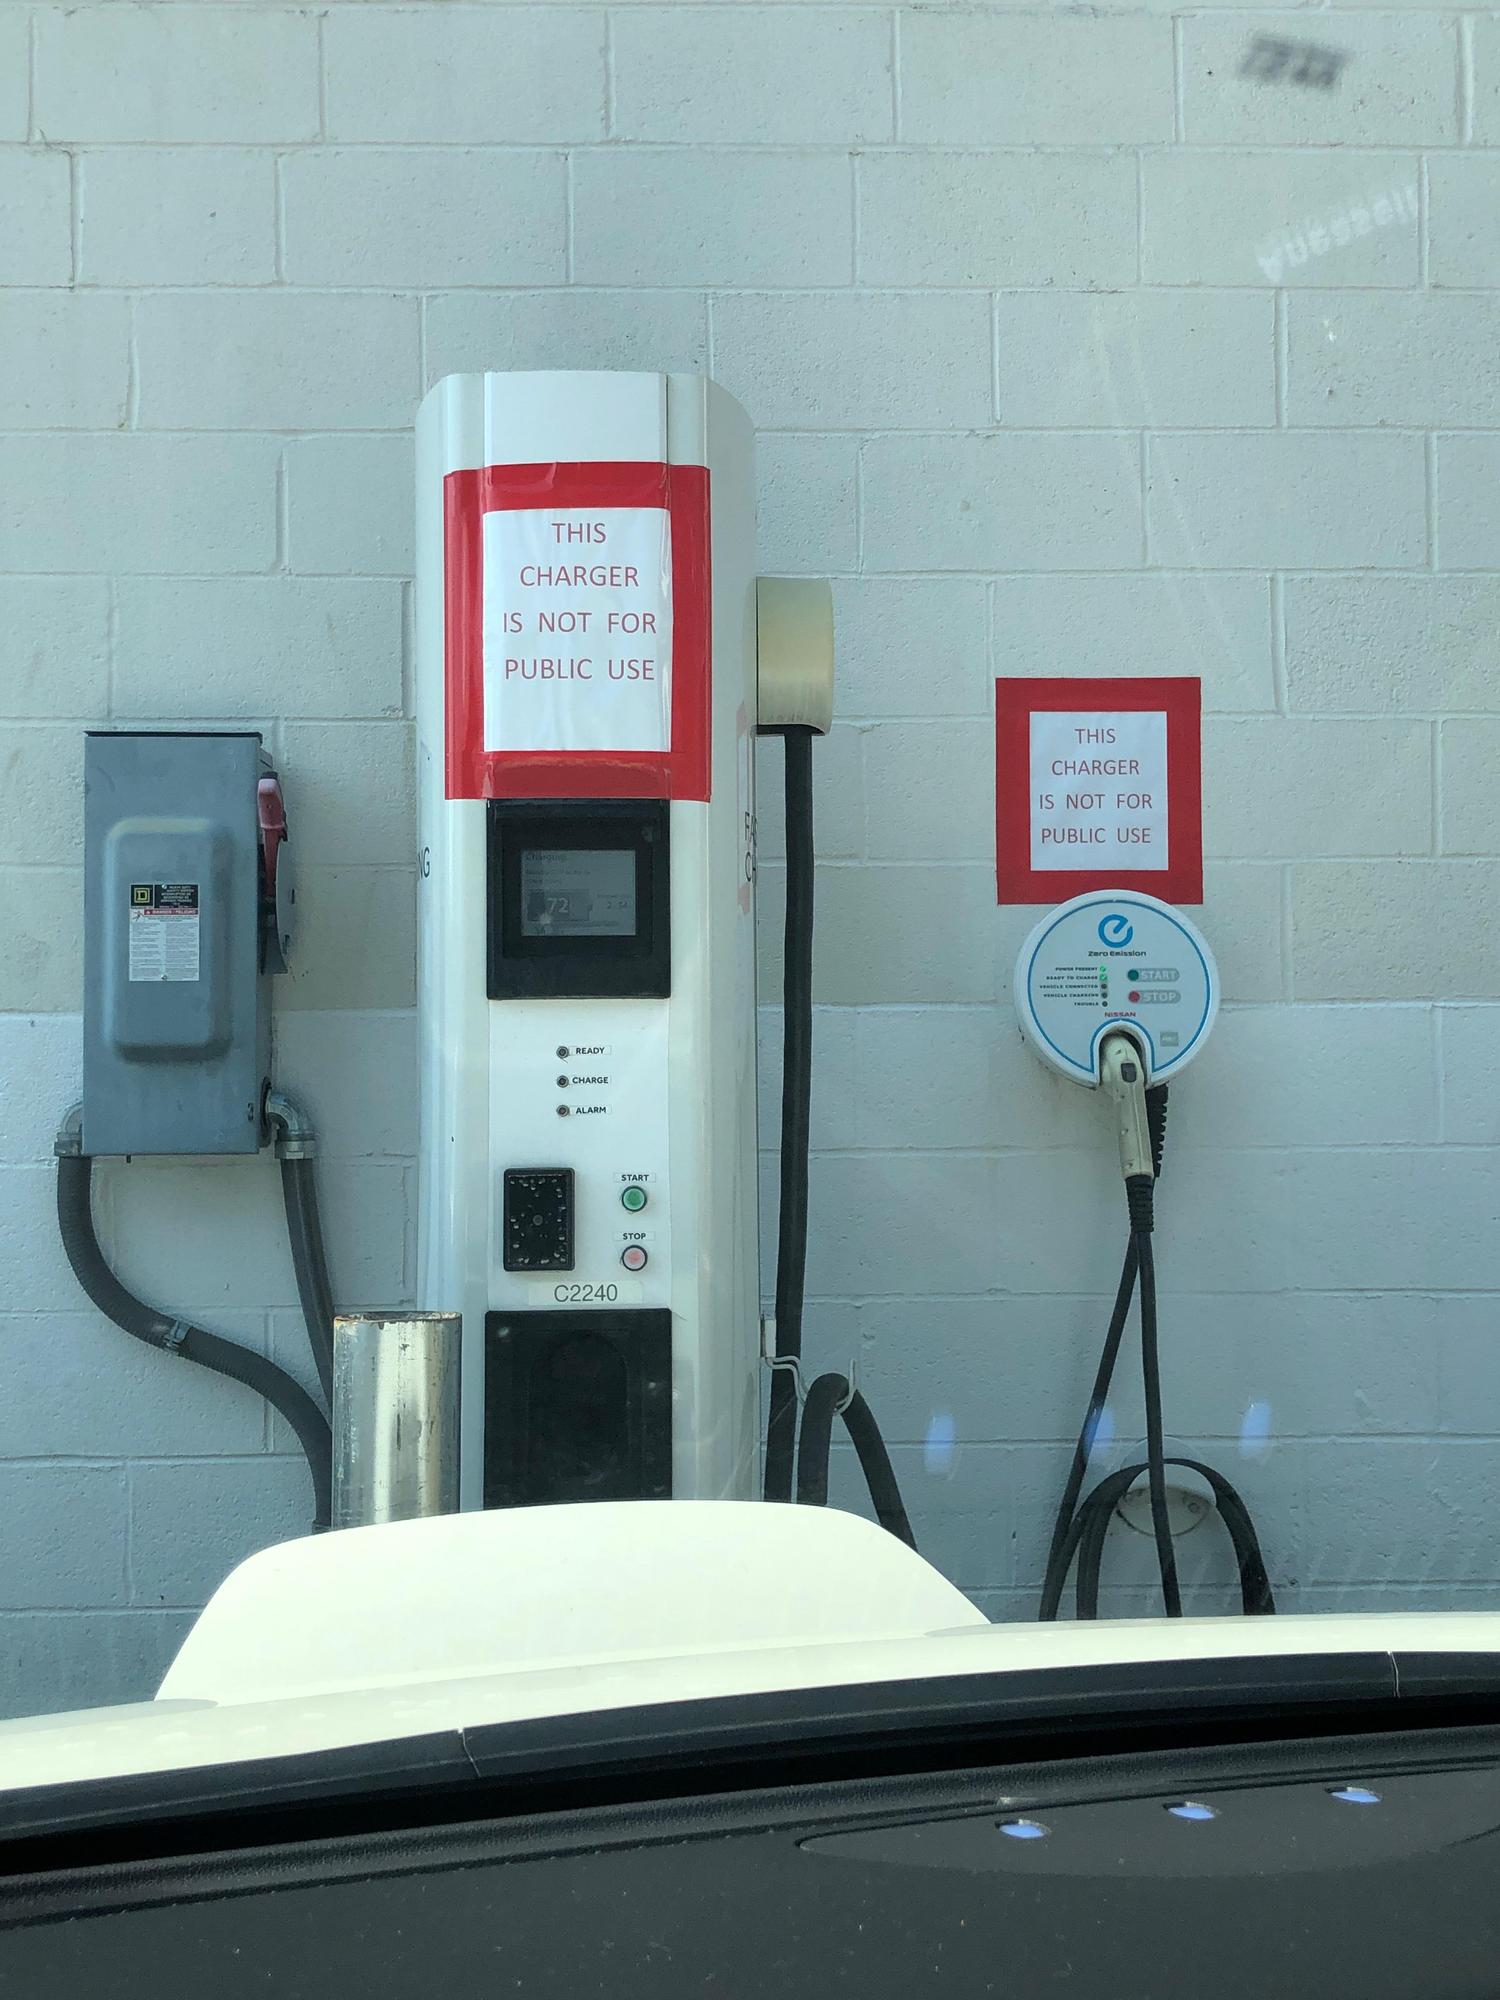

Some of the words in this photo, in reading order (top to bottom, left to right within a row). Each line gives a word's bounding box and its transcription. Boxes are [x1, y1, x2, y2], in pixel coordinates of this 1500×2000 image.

[551, 522, 607, 544] THIS
[520, 565, 639, 587] CHARGER
[503, 612, 523, 634] IS
[538, 611, 593, 633] NOT
[607, 612, 657, 634] FOR
[504, 658, 593, 680] PUBLIC
[608, 659, 655, 681] USE
[1074, 728, 1116, 744] THIS
[1051, 760, 1139, 776] CHARGER
[1039, 794, 1055, 809] IS
[1066, 794, 1106, 809] NOT
[1117, 794, 1153, 809] FOR
[1041, 828, 1106, 844] PUBLIC
[1117, 828, 1152, 844] USE
[1140, 969, 1177, 980] START
[1142, 991, 1177, 1002] STOP
[575, 1046, 605, 1055] READY
[572, 1076, 609, 1085] CHARGE
[575, 1106, 607, 1114] ALARM
[621, 1174, 650, 1182] START
[622, 1232, 647, 1241] STOP
[553, 1283, 619, 1303] C2240
